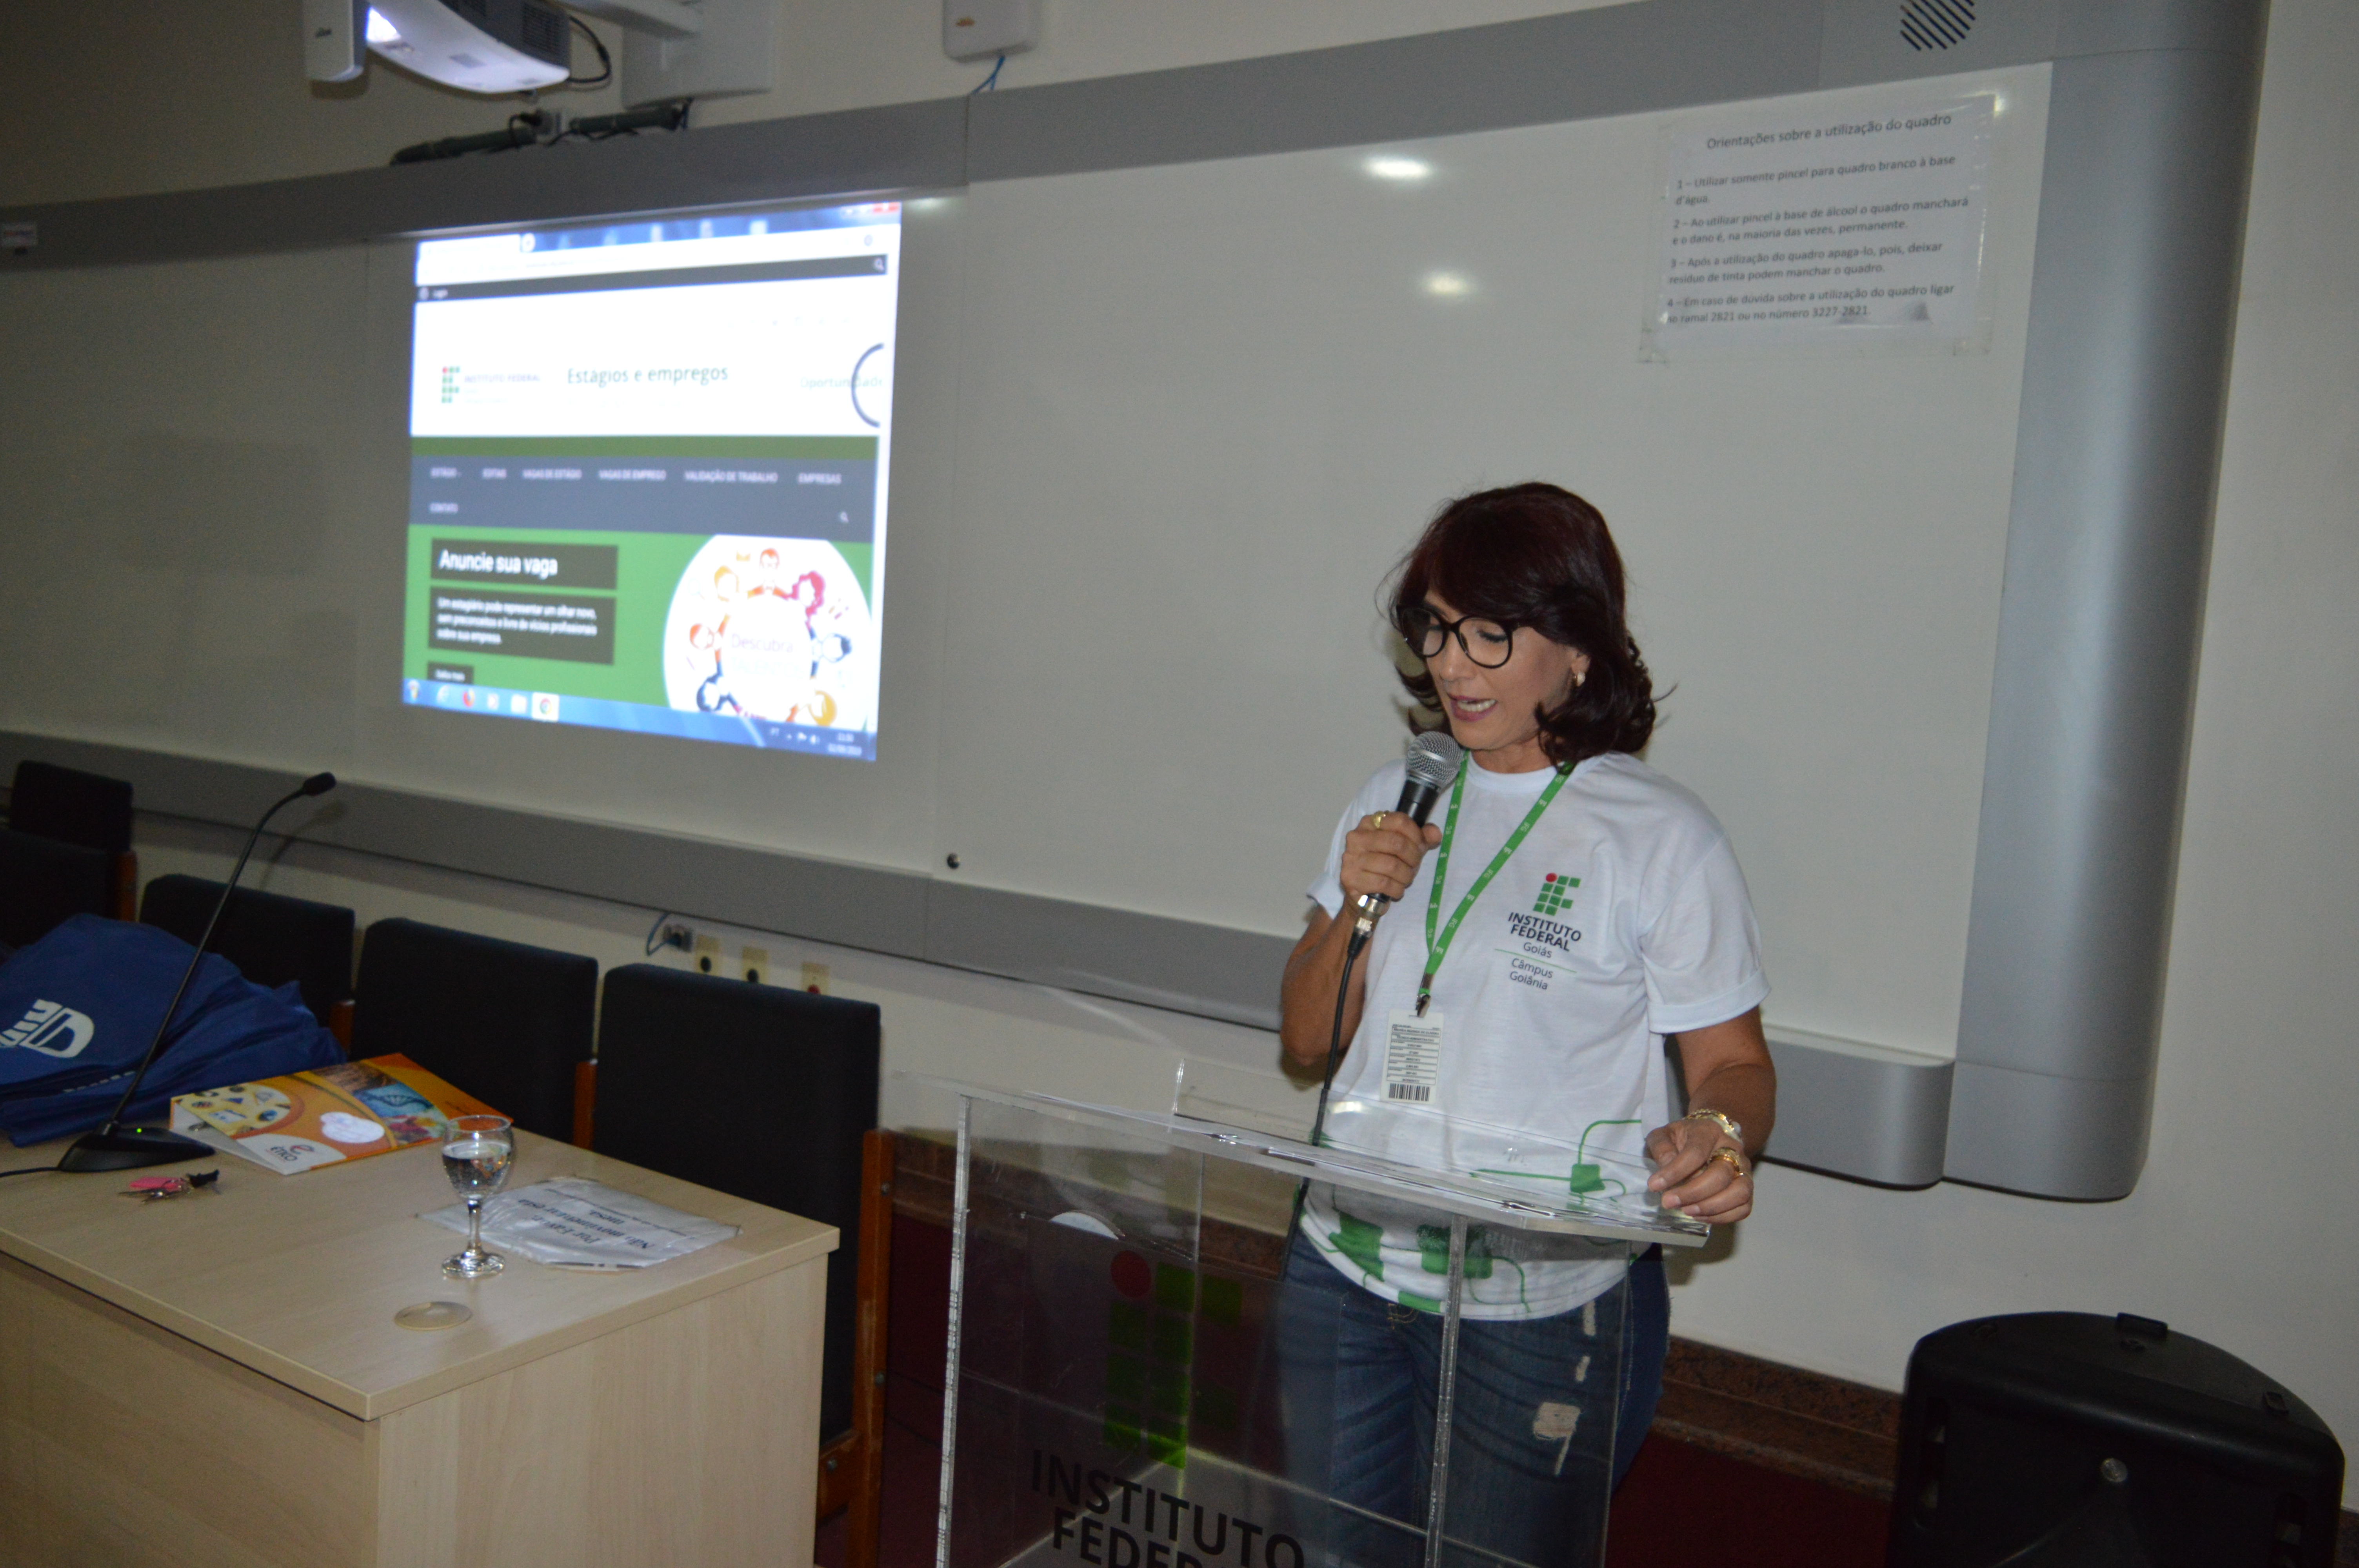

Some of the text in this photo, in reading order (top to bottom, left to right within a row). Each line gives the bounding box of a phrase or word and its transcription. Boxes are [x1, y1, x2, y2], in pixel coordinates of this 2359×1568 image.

[1707, 114, 1952, 149] Orientações sobre a utilização do quadro
[1677, 180, 1683, 189] 1
[1694, 178, 1727, 187] Utilizar
[1731, 172, 1775, 183] somente
[1778, 168, 1808, 181] pincel
[1811, 167, 1834, 178] para
[1837, 163, 1876, 175] quadro
[1879, 159, 1916, 171] branco
[1929, 156, 1956, 166] base
[1674, 219, 1679, 229] 2
[1691, 218, 1704, 227] Ao
[1707, 216, 1740, 226] utilizar
[1743, 212, 1772, 224] pincel
[1784, 210, 1807, 220] base
[1811, 209, 1823, 218] de
[1826, 205, 1857, 216] álcool
[1871, 202, 1909, 214] quadro
[1913, 196, 1968, 210] manchará
[1690, 233, 1714, 243] dano
[1744, 229, 1781, 239] maioria
[1785, 227, 1801, 236] das
[1804, 225, 1835, 235] vezes,
[1671, 258, 1676, 268] 3
[1688, 257, 1711, 268] Após
[1723, 253, 1769, 265] utilização
[1772, 252, 1785, 261] do
[1788, 250, 1825, 262] quadro
[1908, 242, 1943, 253] deixar
[1708, 272, 1719, 282] de
[1723, 272, 1745, 281] tinta
[1748, 270, 1783, 281] podem
[1786, 265, 1830, 277] manchar
[1668, 298, 1673, 307] 4
[1684, 297, 1699, 306] Em
[1727, 295, 1738, 304] de
[1741, 293, 1774, 303] dúvida
[1777, 292, 1806, 302] sobre
[1818, 288, 1868, 300] utilização
[1871, 287, 1884, 297] do
[1888, 285, 1926, 298] quadro
[1930, 285, 1955, 296] ligar
[1681, 314, 1708, 323] ramal
[1711, 312, 1734, 321] 2821
[1769, 309, 1809, 319] número
[568, 367, 728, 388] Estágios e empregos
[798, 473, 842, 484] EMPRESAS
[438, 549, 558, 580] Anuncie sua vaga
[731, 633, 793, 653] Descubra
[1508, 912, 1581, 942] INSTITUTO
[1510, 924, 1570, 952] FEDERAL
[1523, 942, 1552, 958] Goiás
[1512, 958, 1553, 978] Câmpus
[1510, 971, 1548, 990] Goiânia
[1032, 1450, 1305, 1568] INSTITUTO
